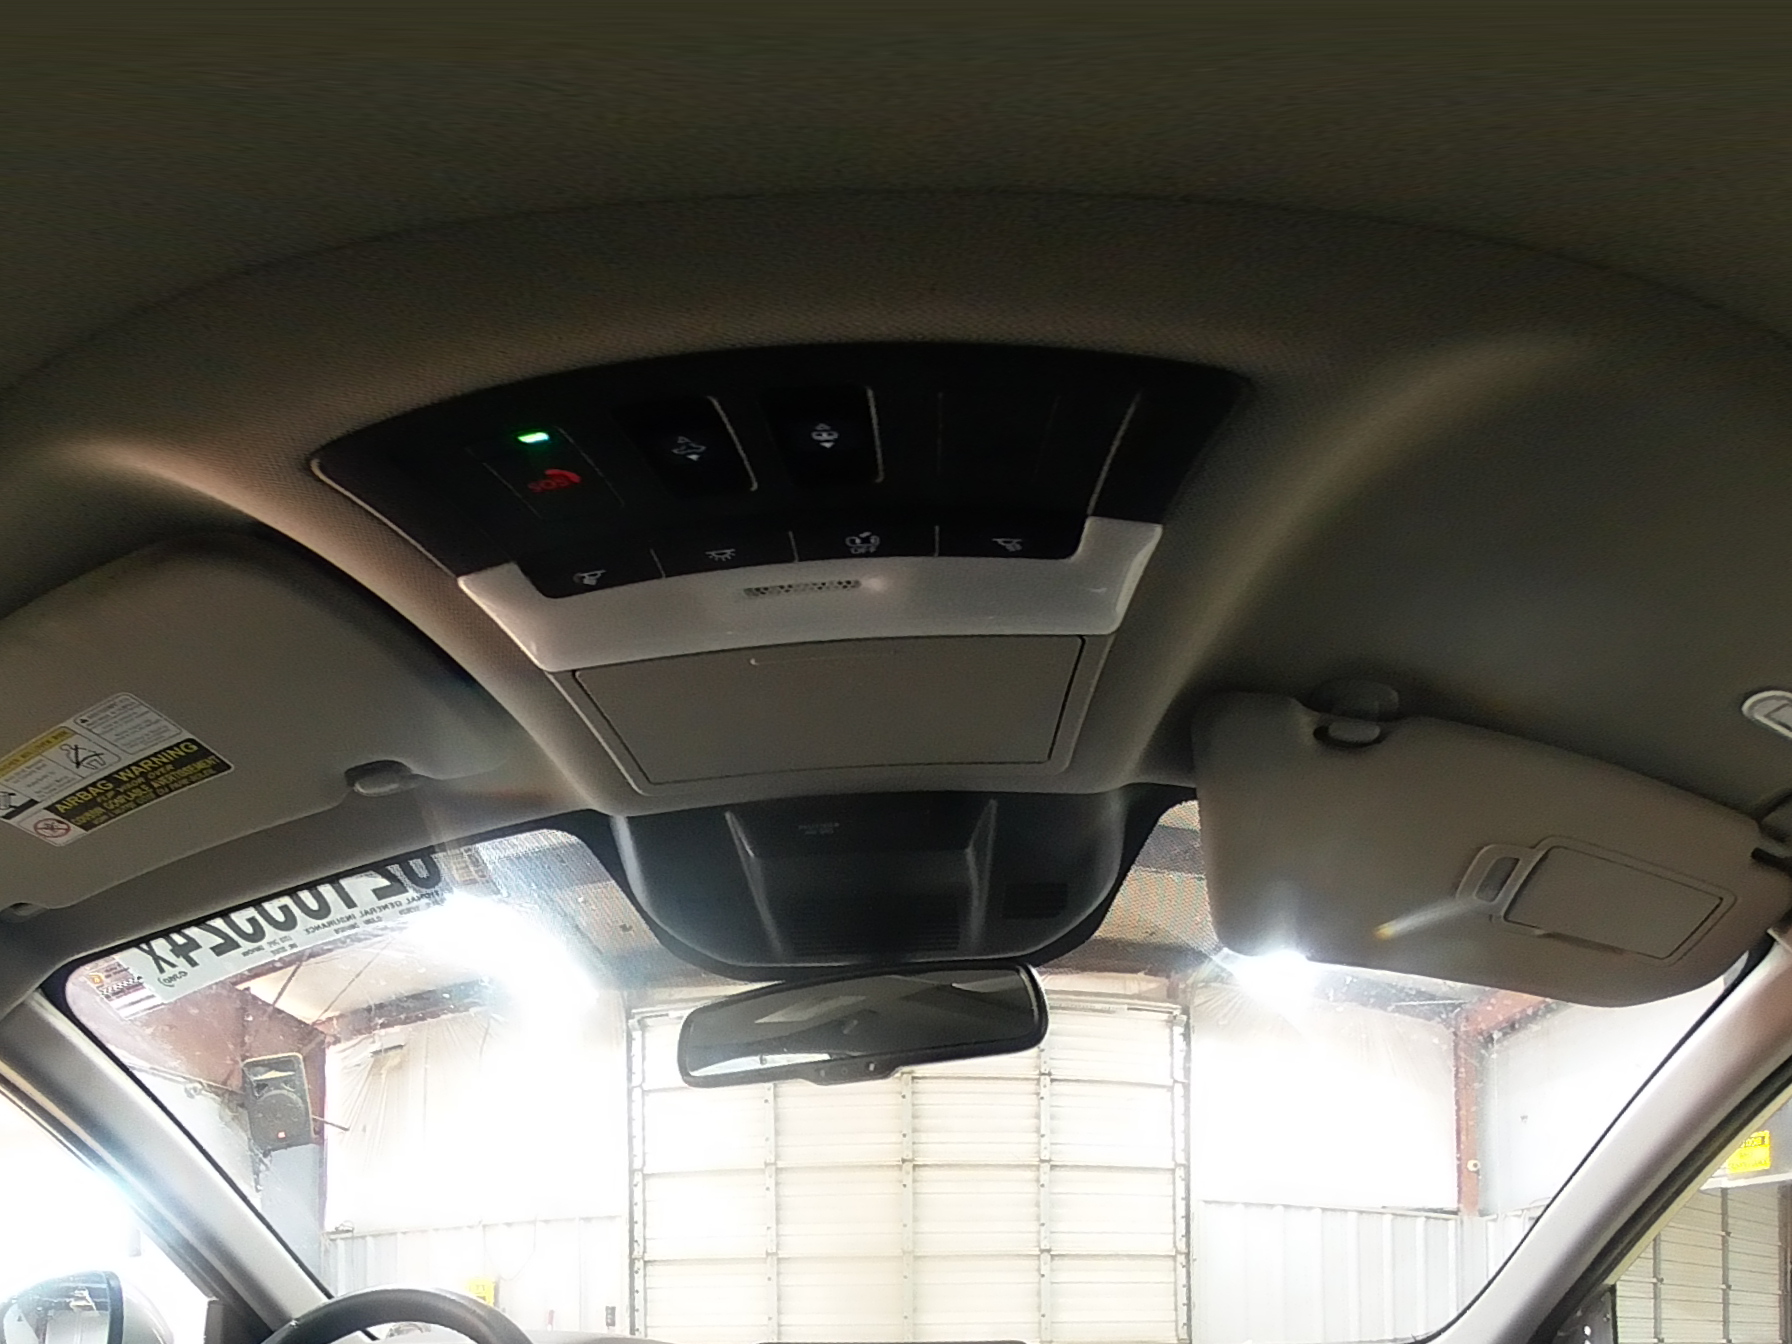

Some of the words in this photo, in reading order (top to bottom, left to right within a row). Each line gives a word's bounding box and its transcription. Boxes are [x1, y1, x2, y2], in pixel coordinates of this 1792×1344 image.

[55, 779, 114, 814] AIRBAG
[115, 741, 198, 782] WARNING
[147, 763, 176, 780] OVER
